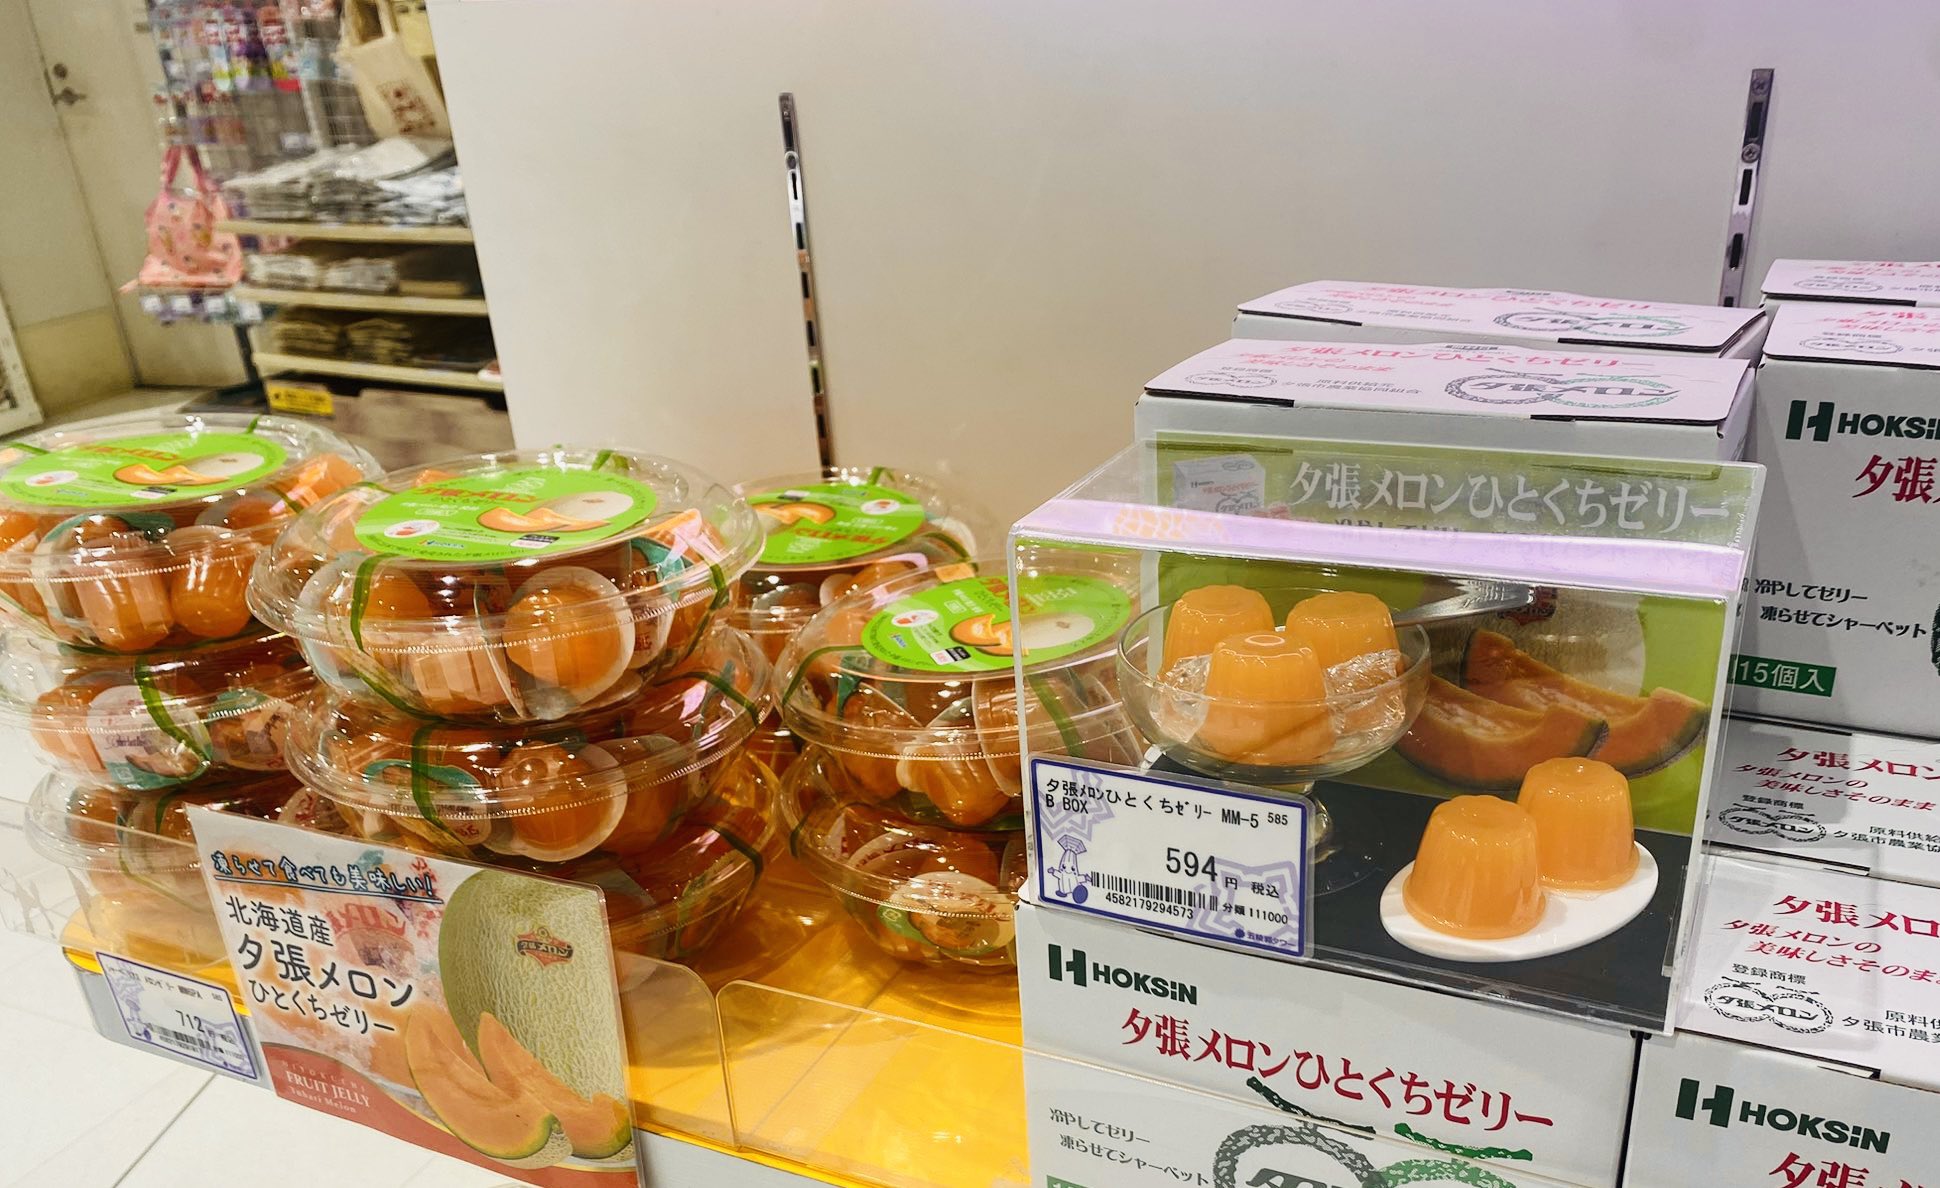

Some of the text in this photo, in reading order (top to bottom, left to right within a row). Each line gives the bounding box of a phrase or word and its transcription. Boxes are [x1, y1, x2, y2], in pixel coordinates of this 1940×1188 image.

[1852, 454, 1940, 504] 夕張
[1290, 461, 1730, 533] 夕張メロンひとくちゼリー
[1754, 578, 1868, 603] 冷やしてゼリー
[1760, 605, 1927, 639] 凍らせてシャーベット
[1738, 660, 1826, 693] 15個入
[1731, 764, 1869, 788] 夕張メロンの
[1045, 793, 1089, 815] B BOX
[1741, 794, 1805, 810] 登録商標
[1753, 779, 1937, 812] 美味しさそのまま
[1222, 810, 1260, 829] MM-5
[1267, 811, 1289, 826] 585
[1729, 815, 1815, 835] 夕張メロン
[1165, 847, 1280, 898] 594 円 税込
[226, 896, 335, 947] 北海道産
[1105, 892, 1195, 920] 4582179294573
[1249, 907, 1289, 925] 111000
[1720, 919, 1883, 954] 夕張メロンの
[238, 933, 413, 1007] 夕張メロン
[1732, 963, 1807, 986] 登録商標
[174, 1009, 206, 1033] 712
[249, 979, 395, 1035] ひとくちゼリー
[1716, 994, 1820, 1021] 夕張メロン
[1121, 1007, 1554, 1132] 夕張メロンひとくちゼリー
[286, 1070, 370, 1108] FRUIT JELLY
[324, 1098, 357, 1114] Melon
[1049, 1106, 1151, 1145] 冷やしてゼリー
[1059, 1133, 1210, 1187] 凍らせてシャーベット
